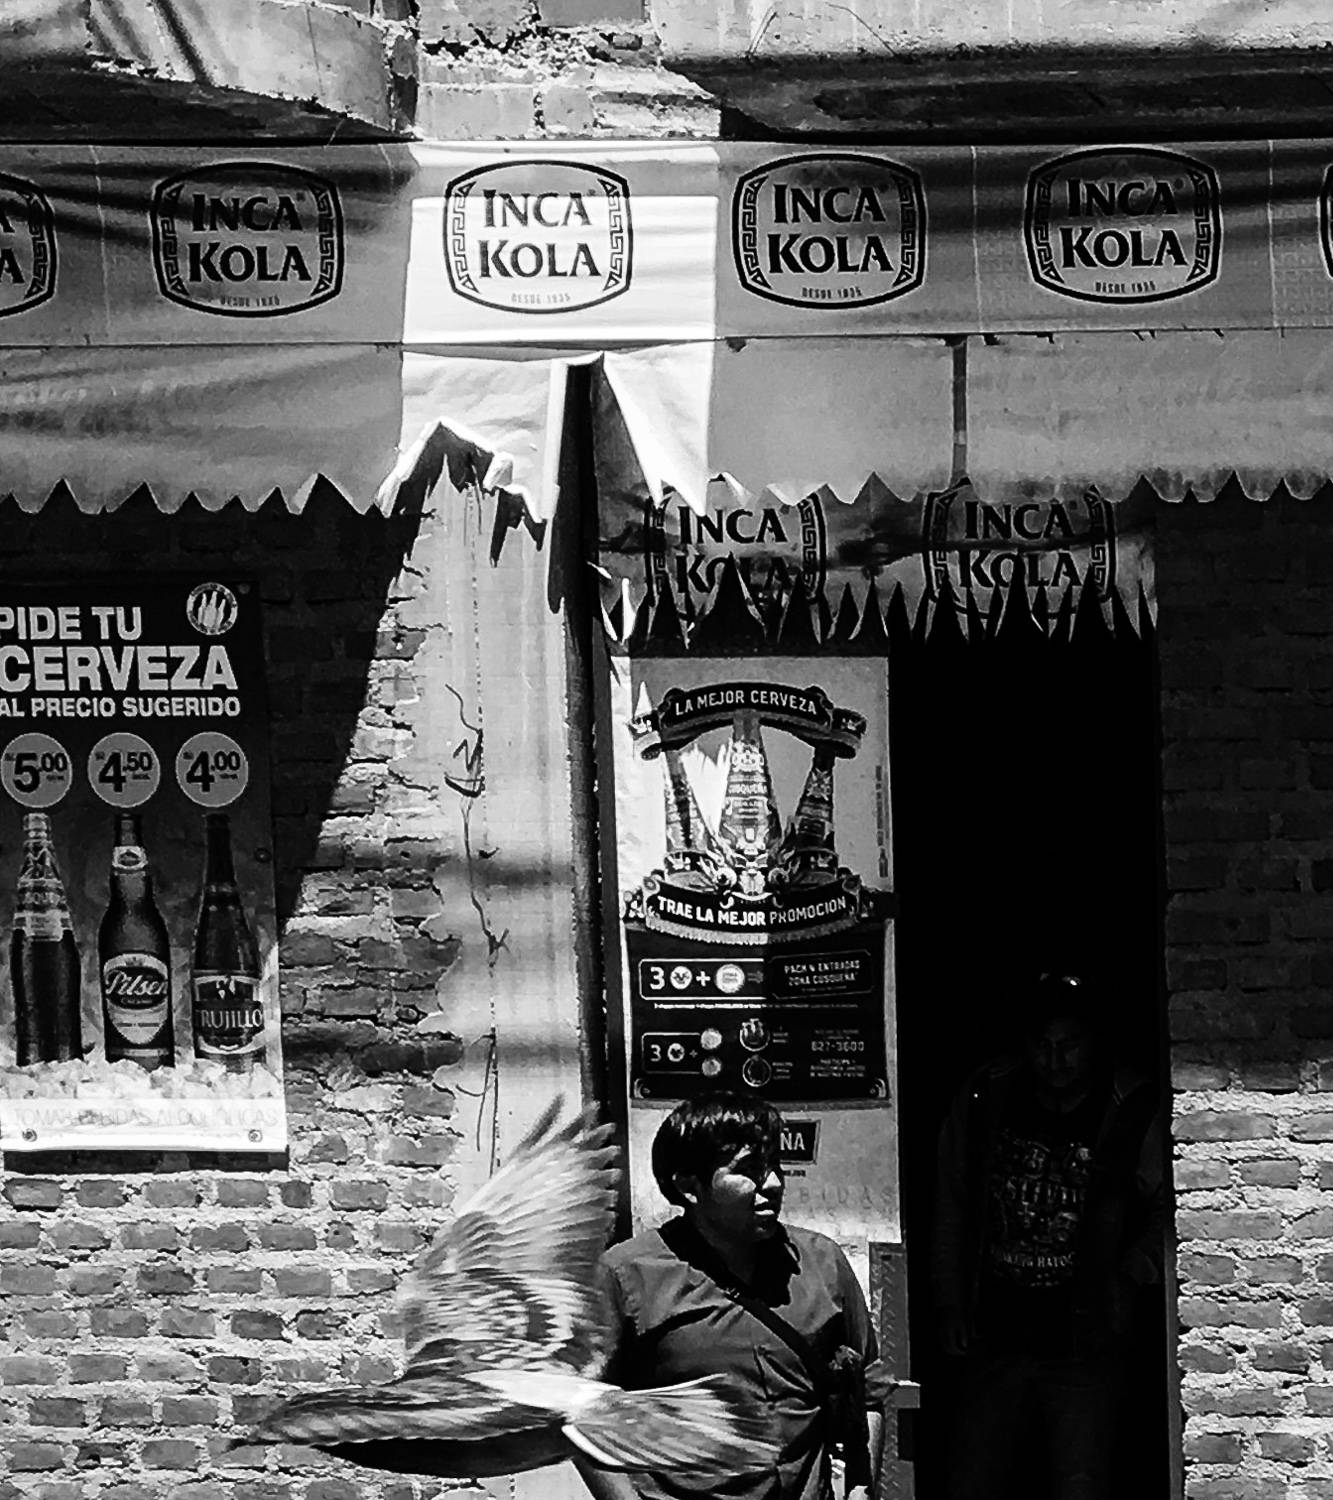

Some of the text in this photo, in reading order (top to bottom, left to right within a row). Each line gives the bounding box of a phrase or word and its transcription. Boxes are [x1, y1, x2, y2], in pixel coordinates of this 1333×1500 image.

[191, 193, 302, 231] INCA
[484, 188, 592, 227] INCA
[773, 184, 886, 222] INCA
[1067, 180, 1178, 218] INCA
[187, 243, 311, 282] KOLA
[479, 239, 600, 278] KOLA
[768, 234, 894, 274] KOLA
[1060, 227, 1188, 267] KOLA
[680, 505, 788, 543] INCA
[965, 504, 1072, 540] INCA
[960, 552, 1082, 589] KOLA
[0, 606, 142, 641] PIDE TU
[0, 645, 239, 693] CERVEZA
[0, 697, 241, 718] AL PRECIO SUGERIDO
[675, 690, 817, 716] LA MEJOR CERVEZA
[13, 752, 68, 793] 5.00
[99, 752, 153, 793] 4.50
[186, 751, 241, 793] 4.00
[657, 896, 693, 919] TRAE
[696, 907, 714, 922] LA
[717, 910, 766, 926] MEJOR
[105, 969, 168, 996] Pilsen
[650, 967, 665, 990] 3
